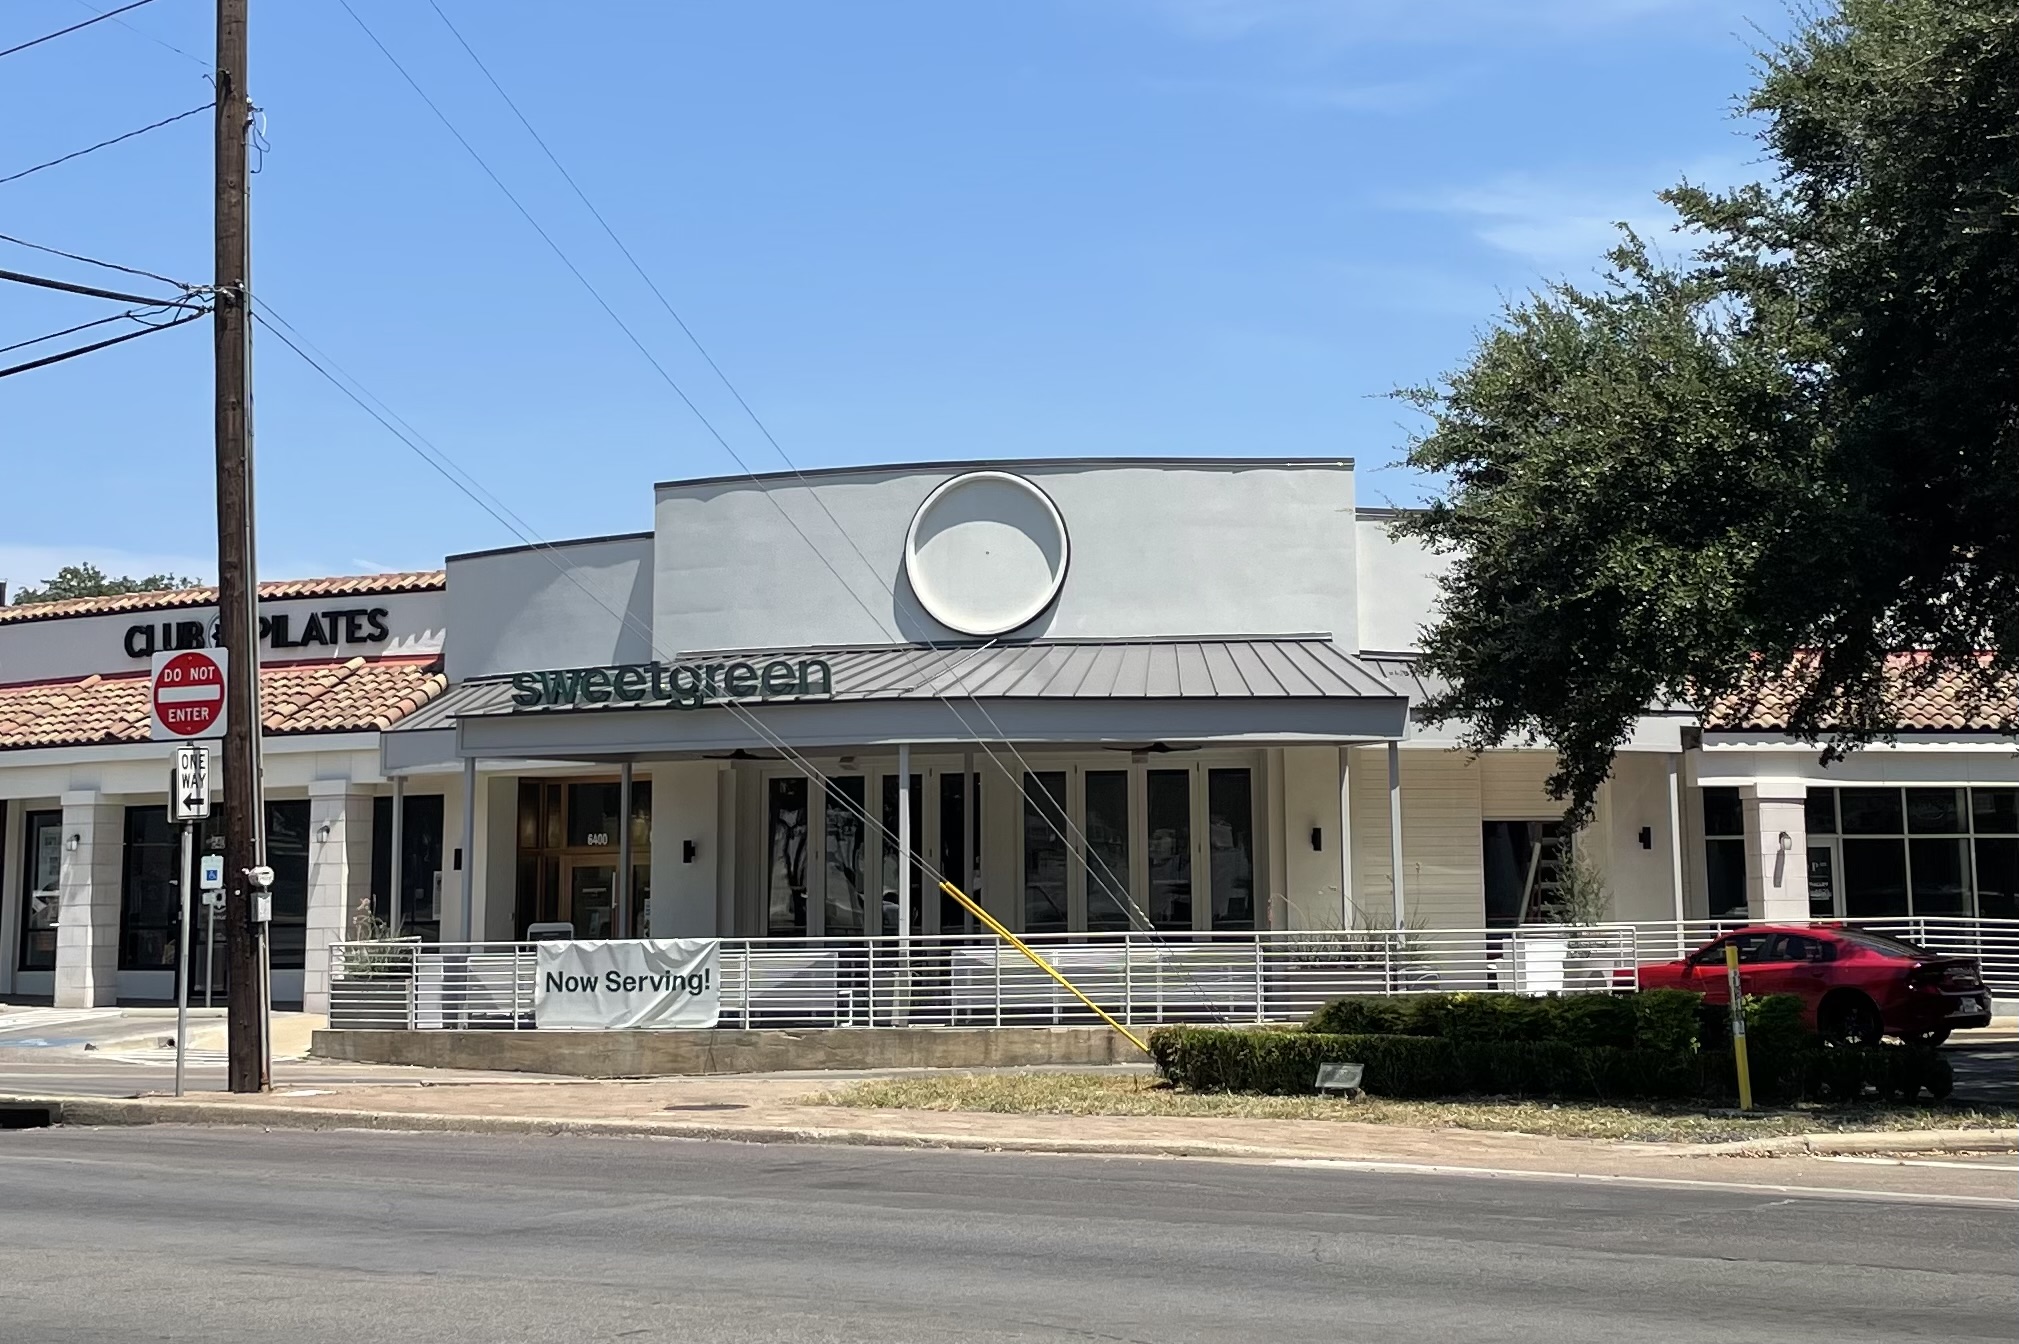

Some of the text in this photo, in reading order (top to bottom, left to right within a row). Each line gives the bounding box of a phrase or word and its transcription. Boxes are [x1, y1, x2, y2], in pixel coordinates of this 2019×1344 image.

[124, 621, 205, 658] CLUB
[164, 666, 215, 682] DO NOT
[511, 660, 832, 710] sweetgreen
[168, 707, 209, 722] ENTER
[182, 754, 206, 770] ONE
[182, 773, 206, 789] WAY
[587, 833, 609, 846] 6400
[546, 968, 711, 996] Now Serving!
